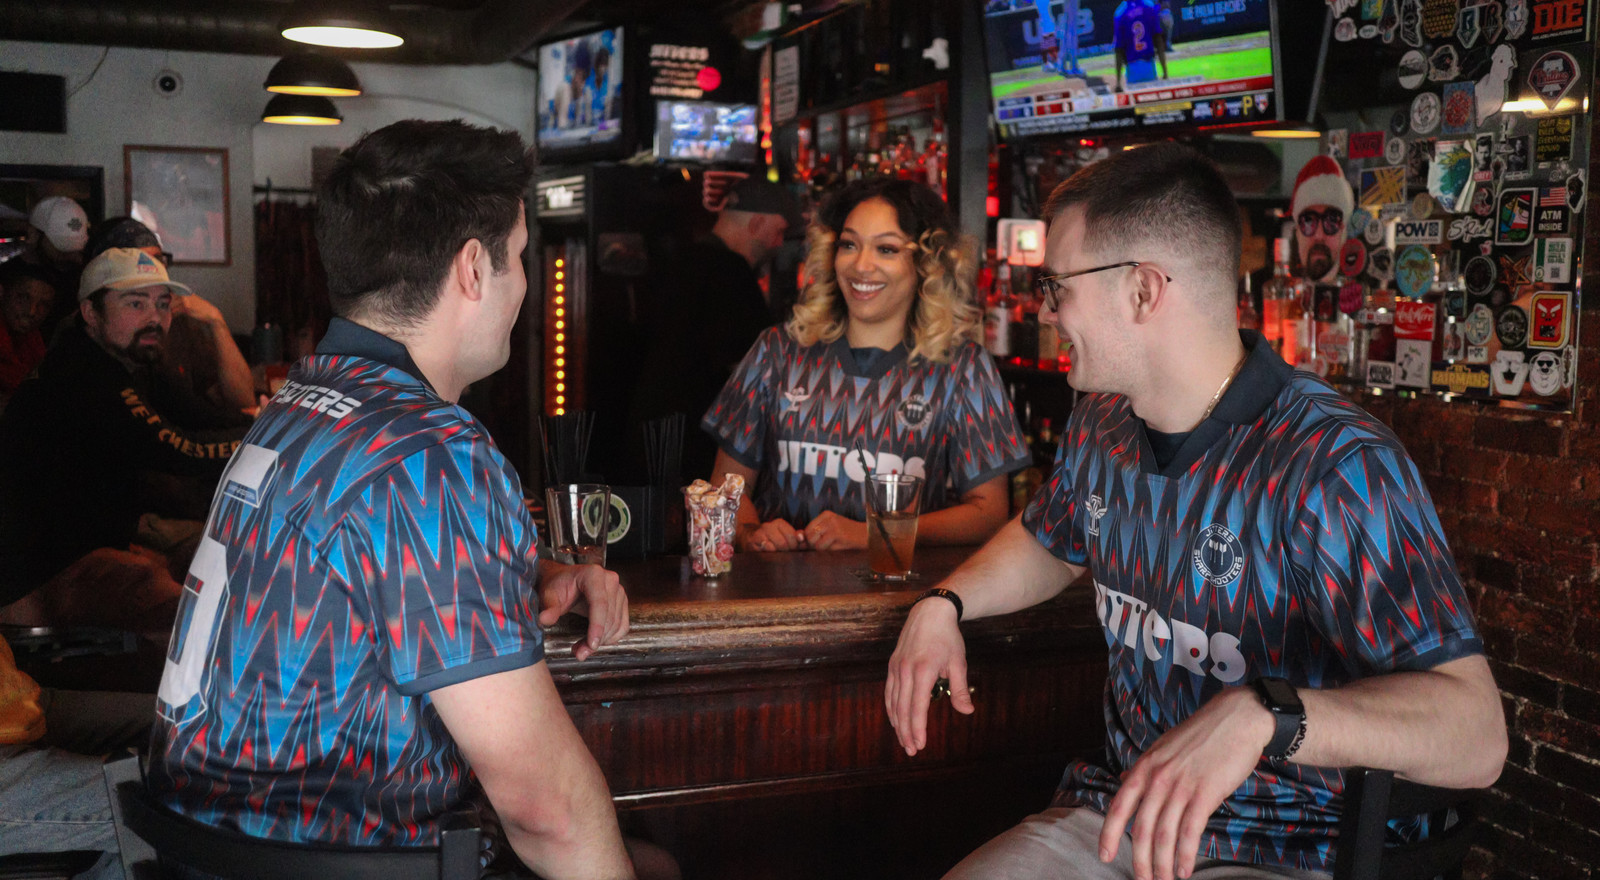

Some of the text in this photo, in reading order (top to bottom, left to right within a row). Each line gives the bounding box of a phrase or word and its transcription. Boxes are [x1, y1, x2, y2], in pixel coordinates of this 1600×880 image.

[1532, 1, 1584, 35] DIE
[1541, 210, 1562, 220] ATM
[1396, 222, 1428, 237] POW
[1538, 222, 1563, 231] INSIDE
